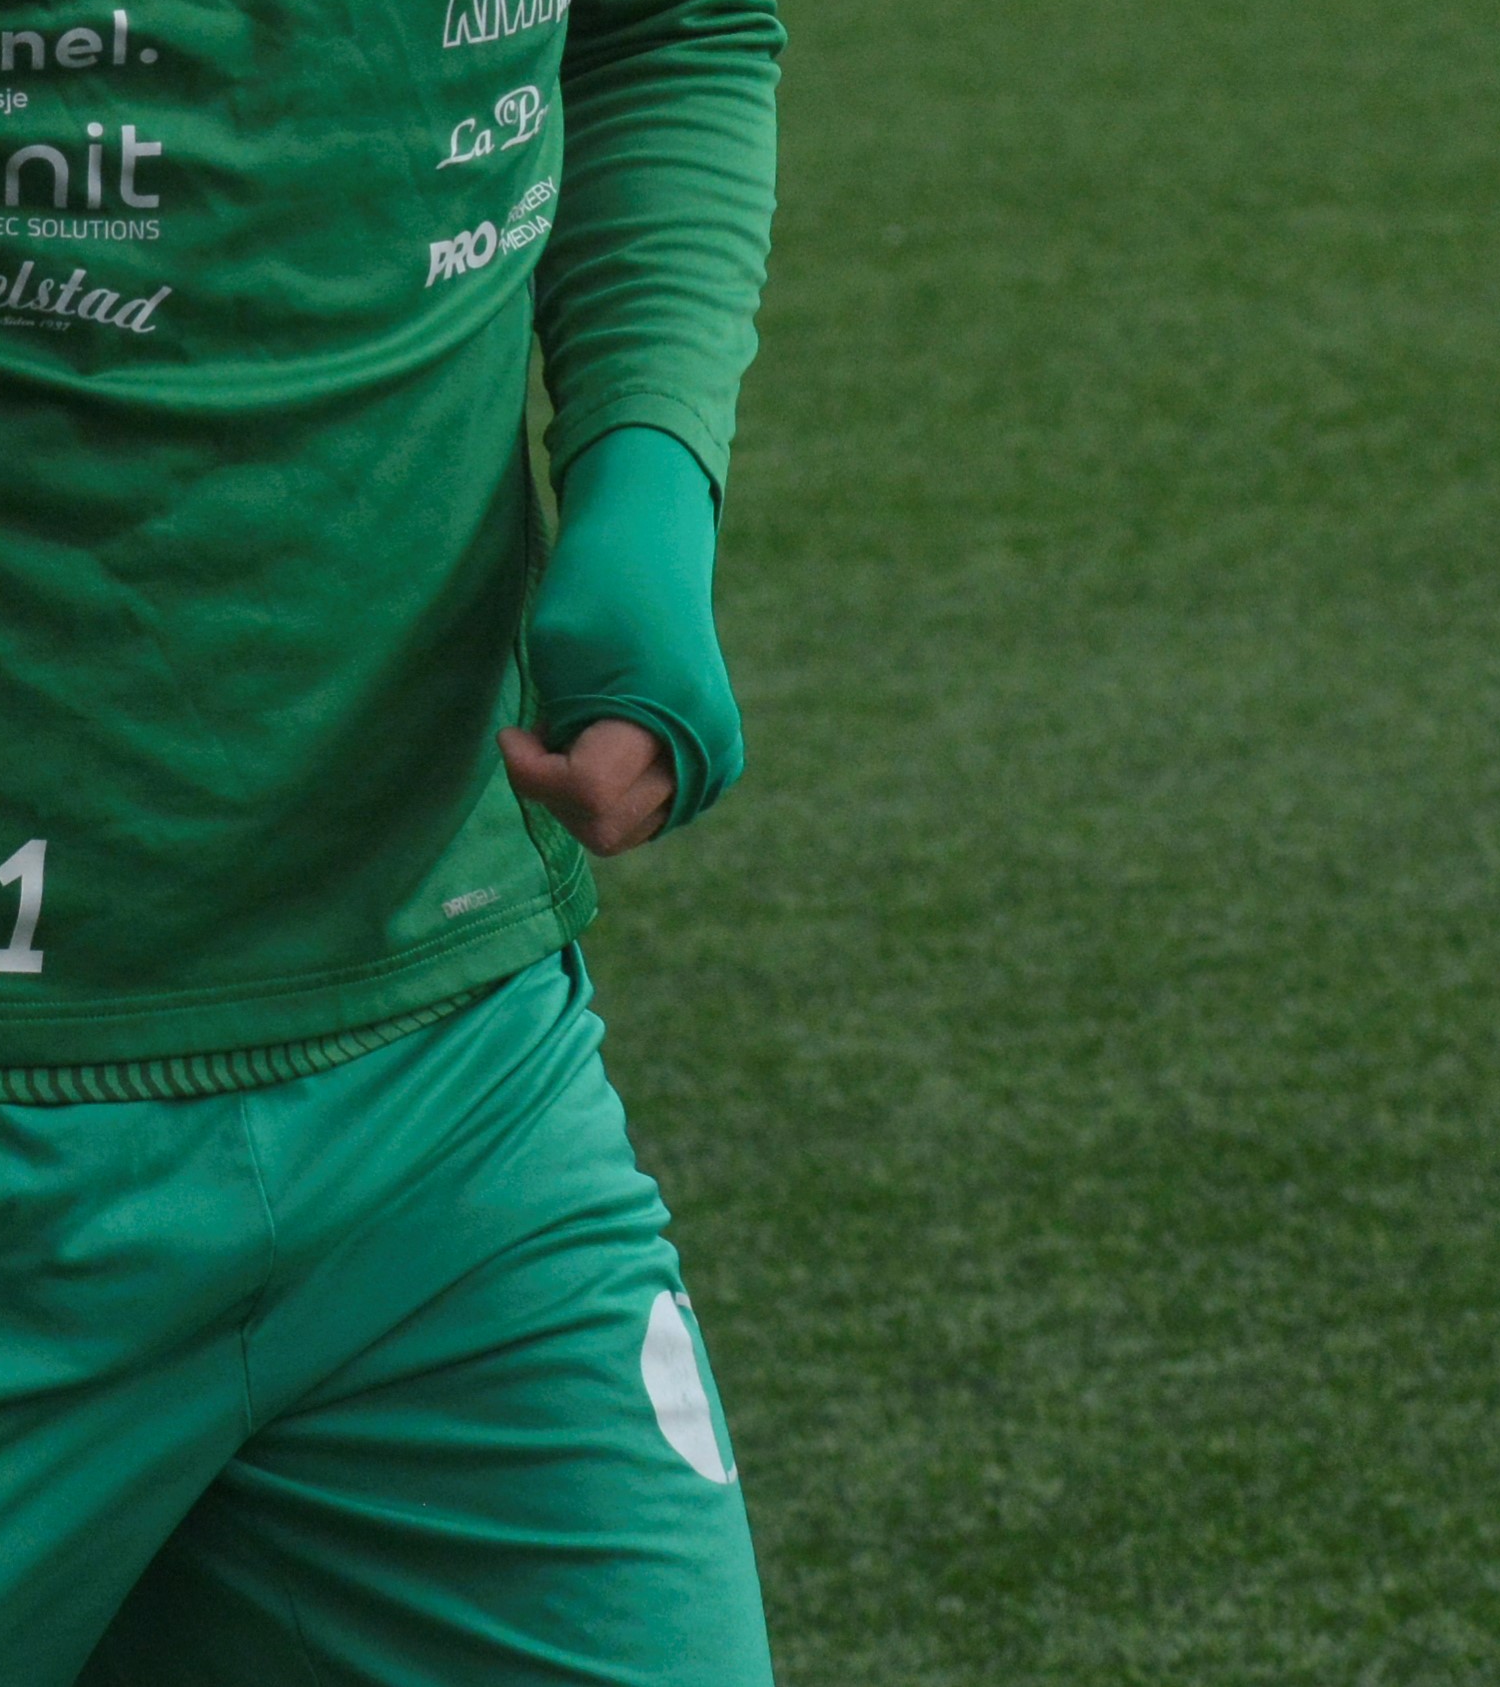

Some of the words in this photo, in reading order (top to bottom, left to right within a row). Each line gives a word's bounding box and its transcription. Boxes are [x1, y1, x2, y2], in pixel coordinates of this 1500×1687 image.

[436, 118, 494, 170] La
[27, 217, 160, 240] SOLUTIONS
[500, 215, 552, 255] MEDIA
[425, 221, 498, 288] PRO
